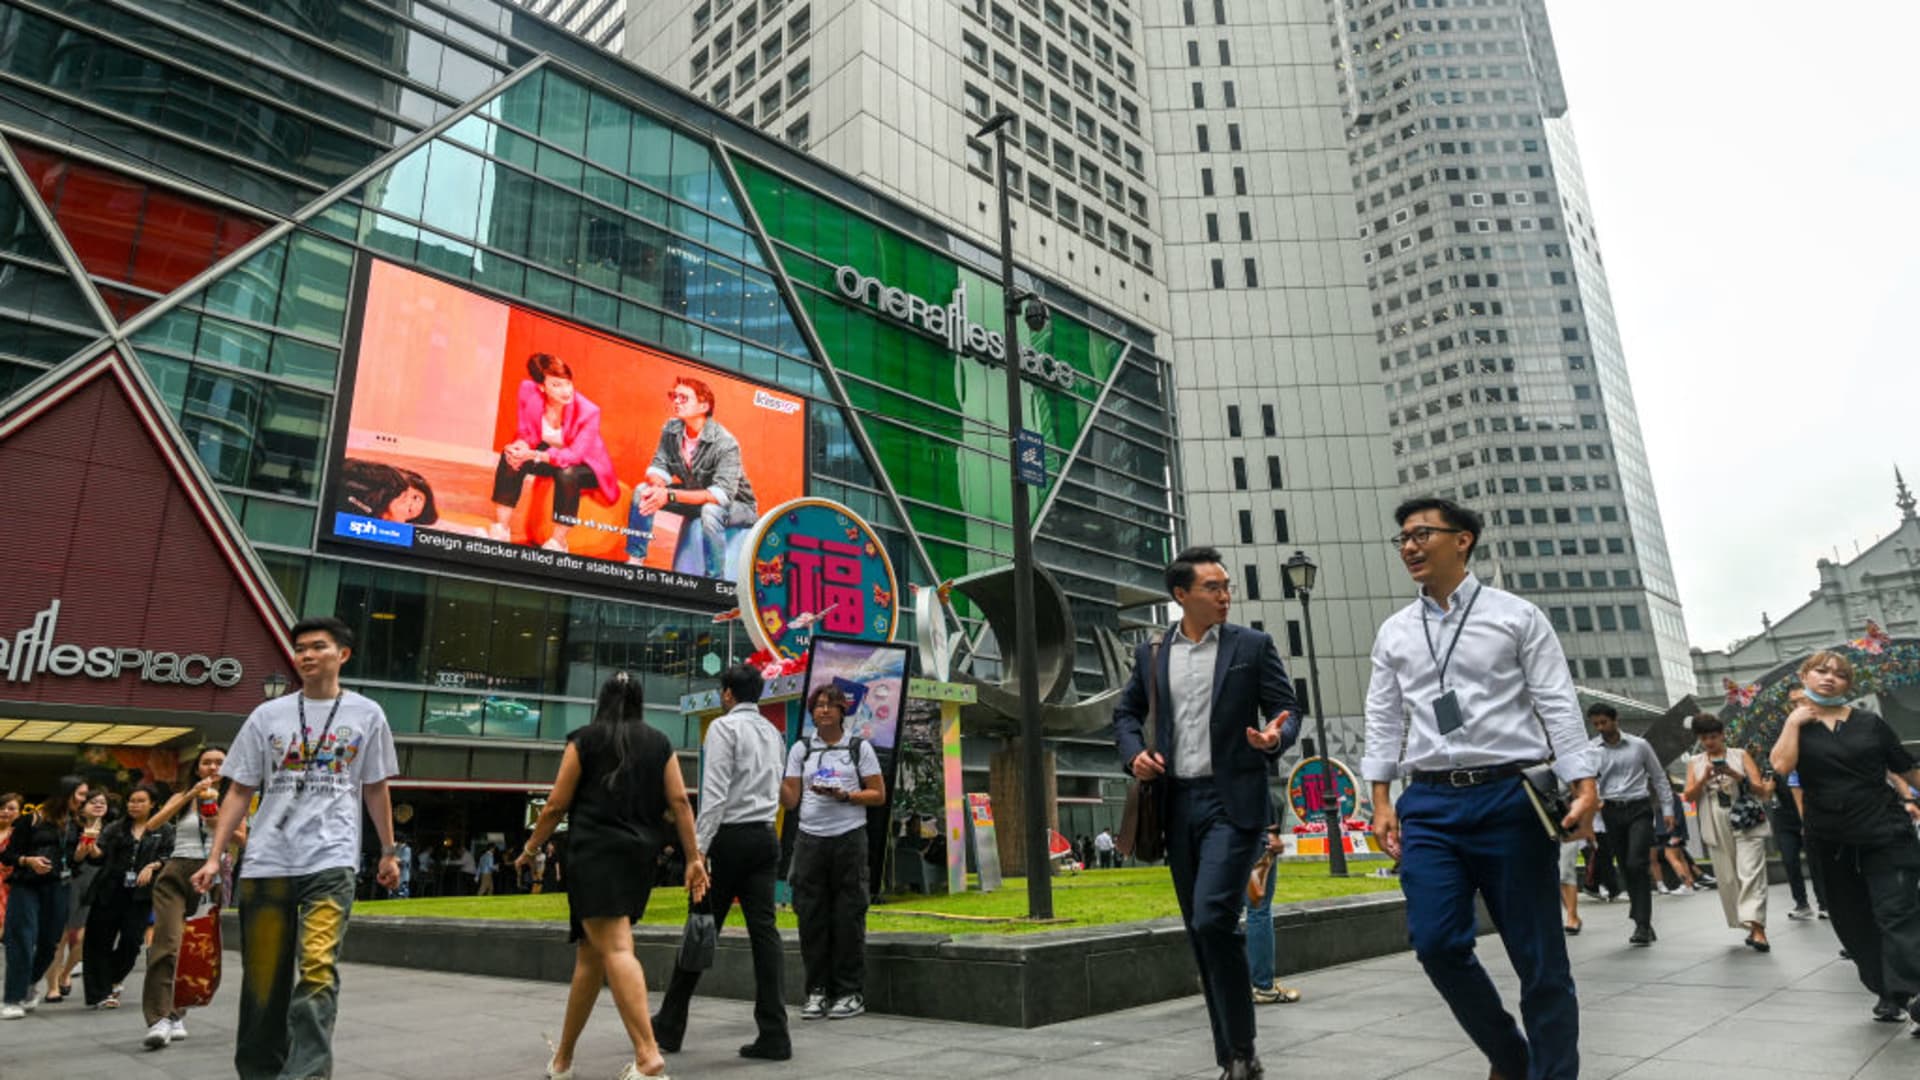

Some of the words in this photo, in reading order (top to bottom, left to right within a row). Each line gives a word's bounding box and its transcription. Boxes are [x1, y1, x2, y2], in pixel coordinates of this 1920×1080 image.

[350, 521, 377, 535] sph
[466, 540, 519, 558] attacker
[521, 549, 554, 565] killed
[556, 556, 583, 569] after
[586, 560, 634, 580] stabbing
[636, 569, 644, 580] 5
[646, 571, 657, 582] in
[788, 533, 866, 635] 福
